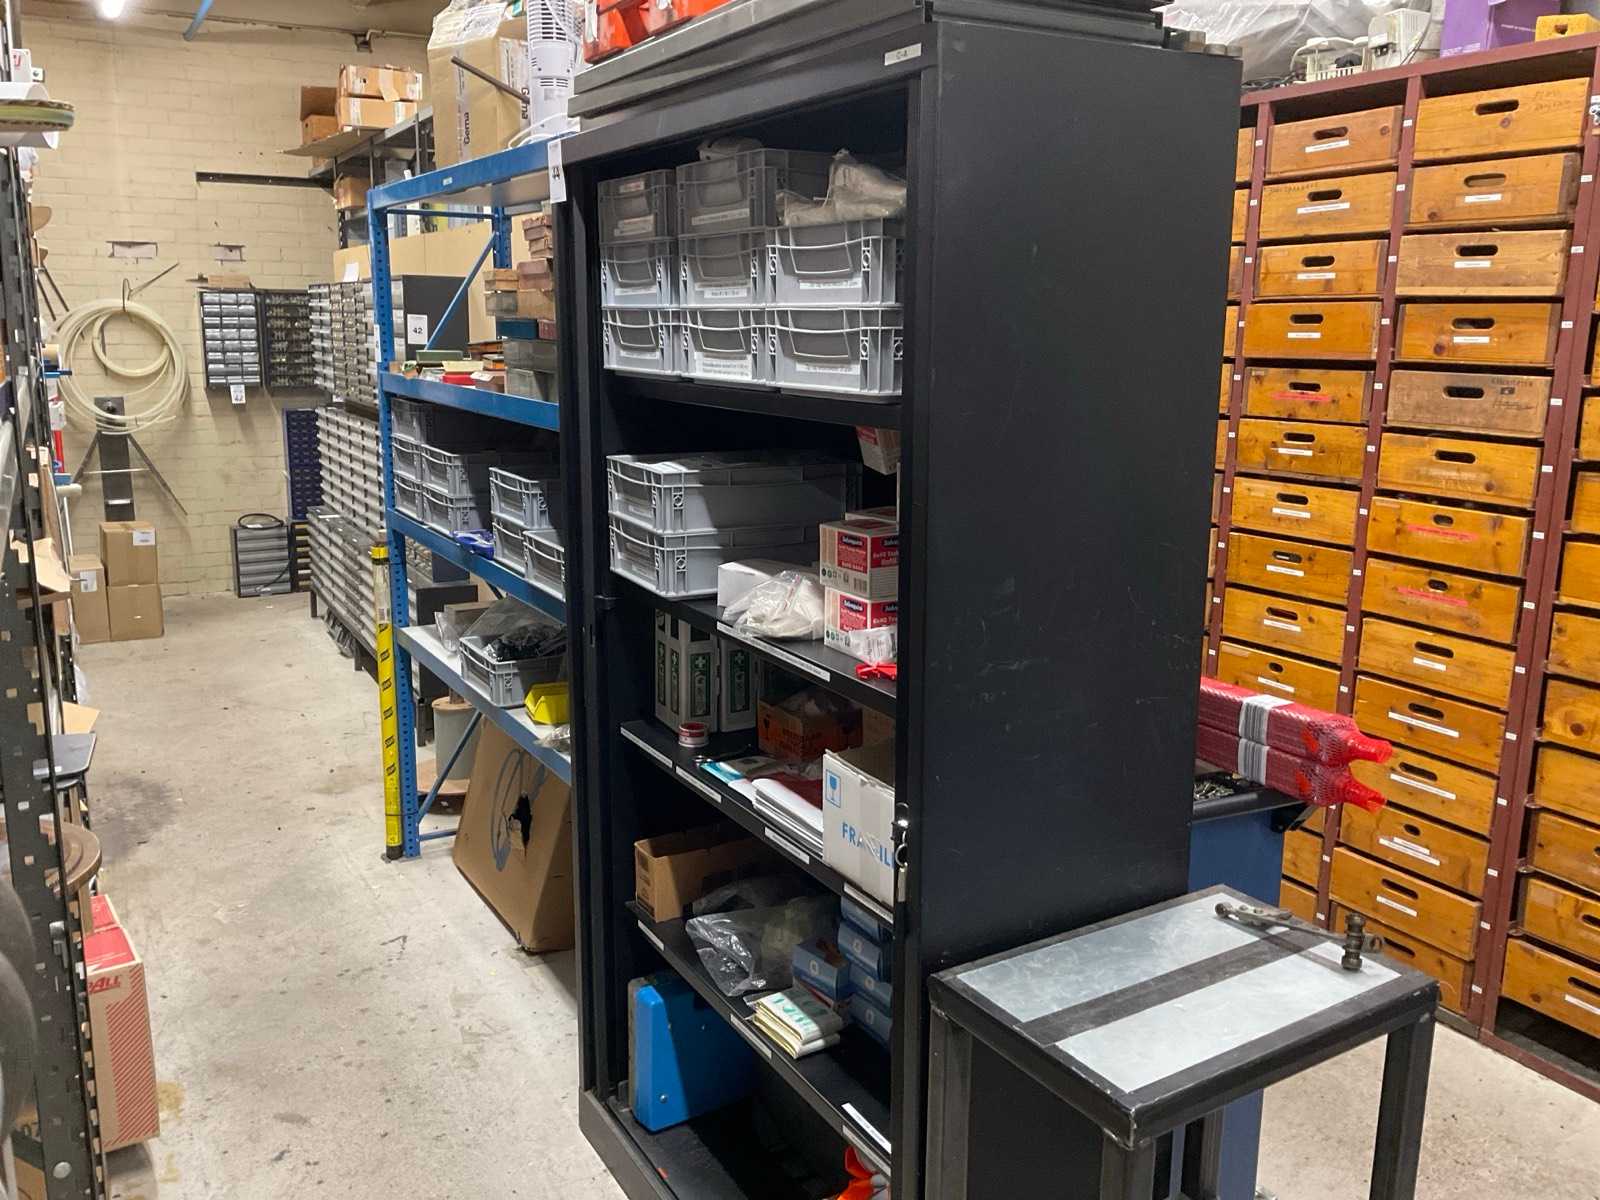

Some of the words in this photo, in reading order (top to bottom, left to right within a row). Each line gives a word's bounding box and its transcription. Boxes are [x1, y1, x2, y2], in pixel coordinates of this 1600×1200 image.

[521, 87, 530, 120] Gma
[412, 327, 423, 335] 42
[842, 821, 895, 869] FRAIL
